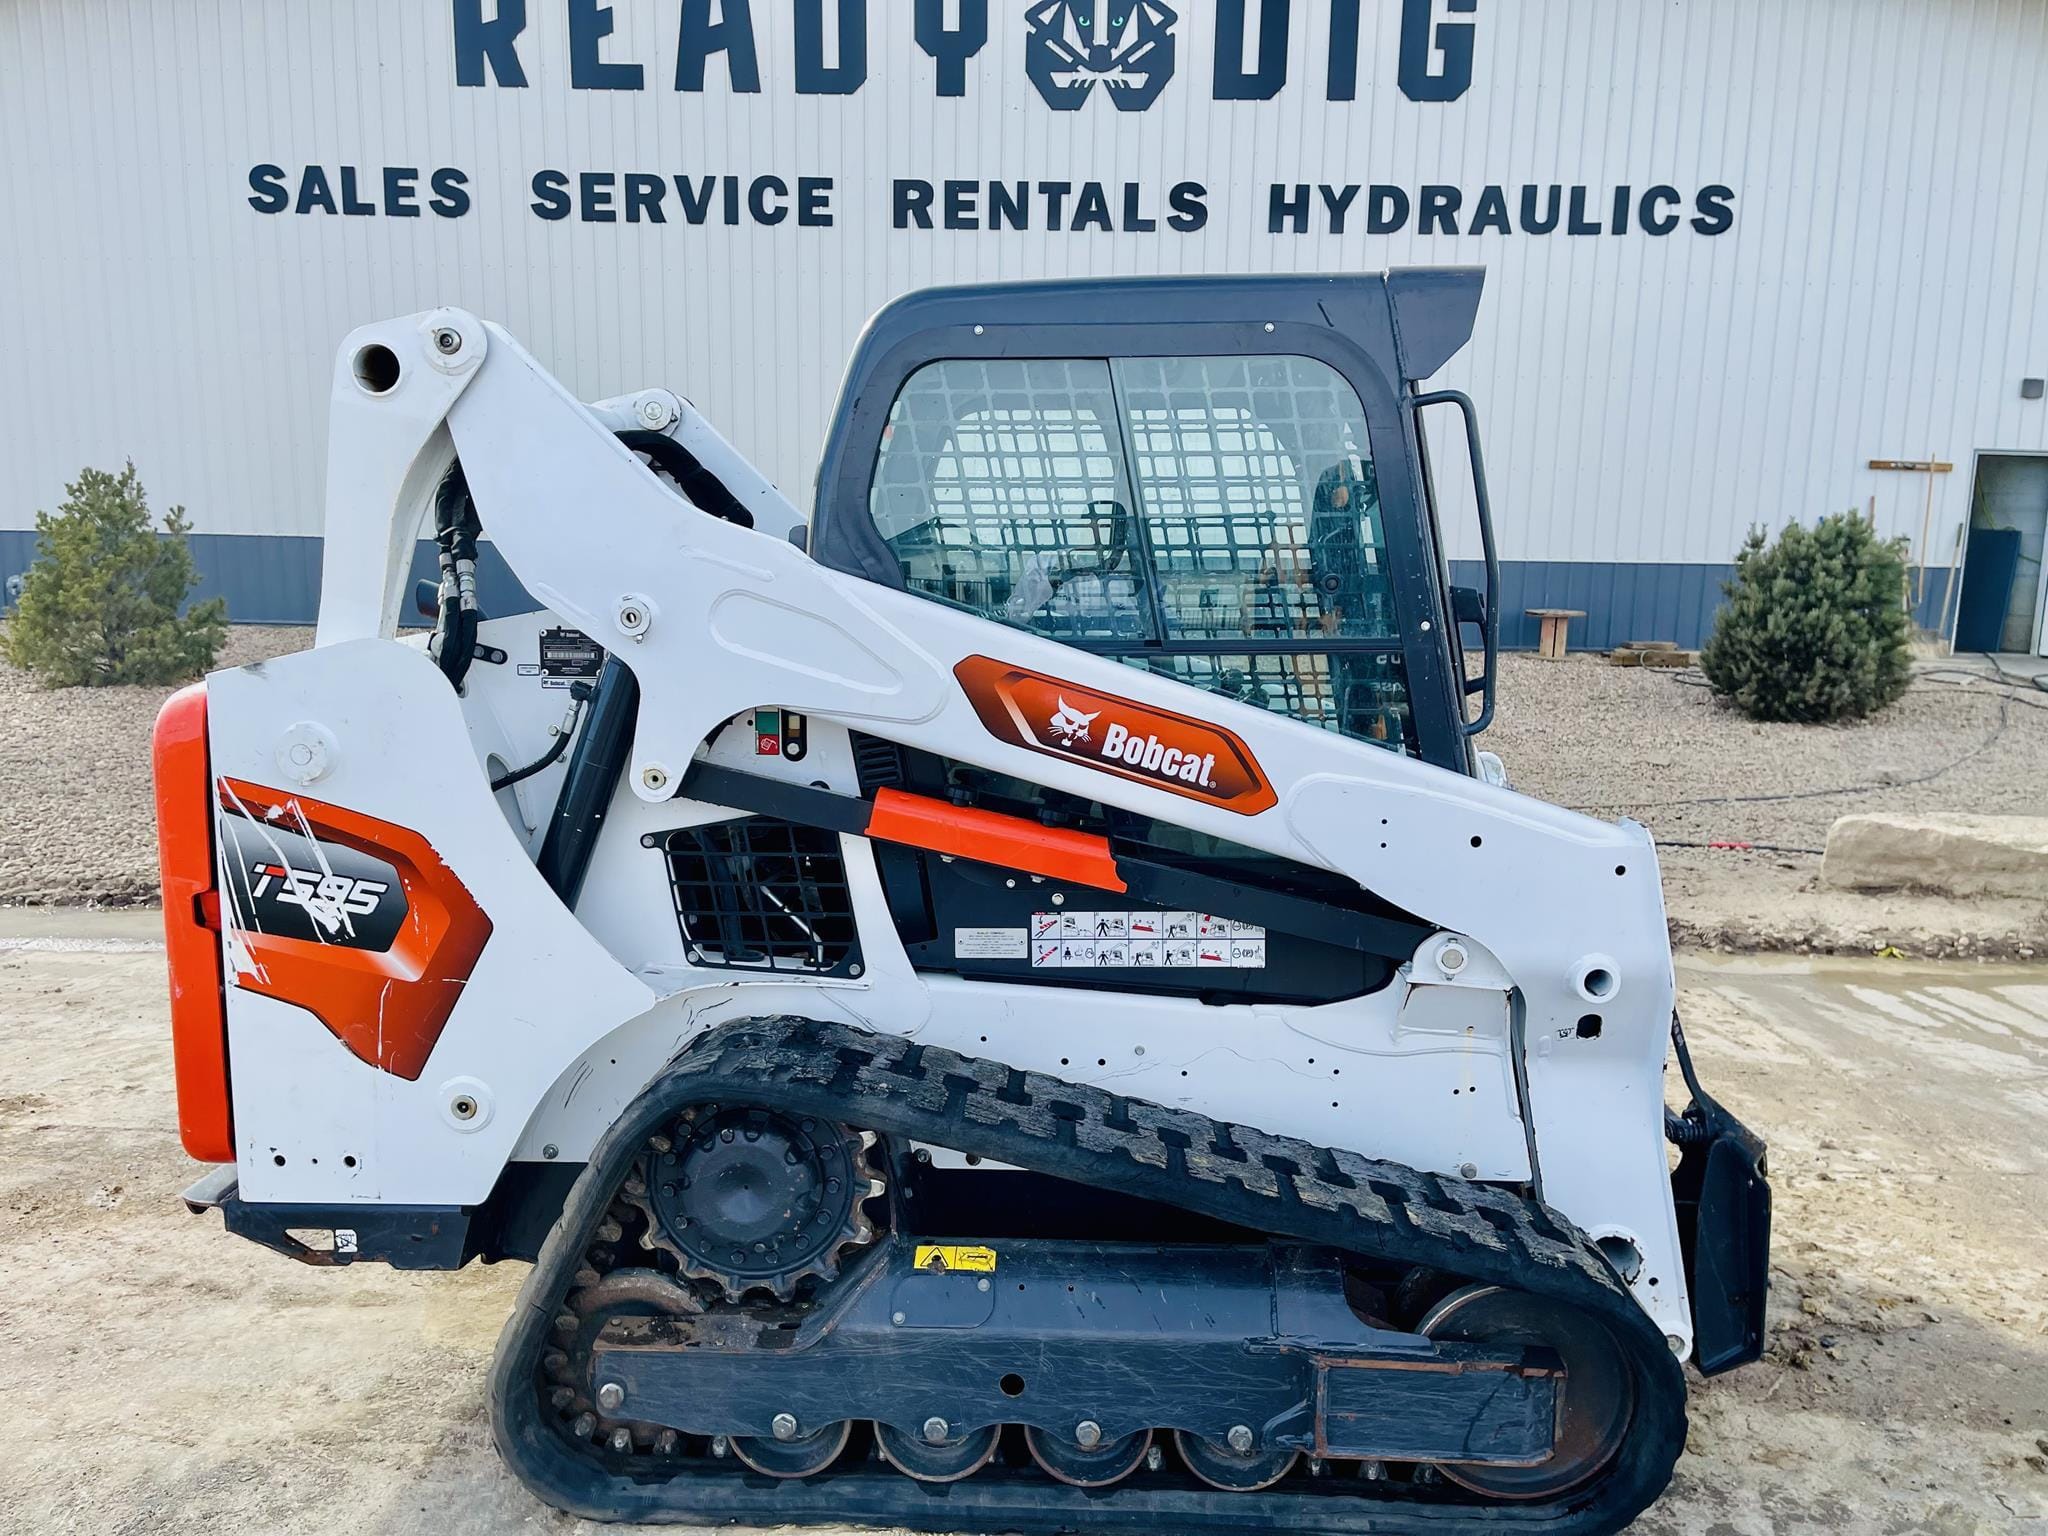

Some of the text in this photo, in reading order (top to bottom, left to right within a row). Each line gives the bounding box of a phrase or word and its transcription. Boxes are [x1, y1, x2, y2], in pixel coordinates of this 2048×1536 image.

[454, 0, 1477, 102] READY DIG
[247, 163, 1736, 236] SALES SERVICE RENTALS HYDRAULICS
[1101, 722, 1217, 788] Bobcat
